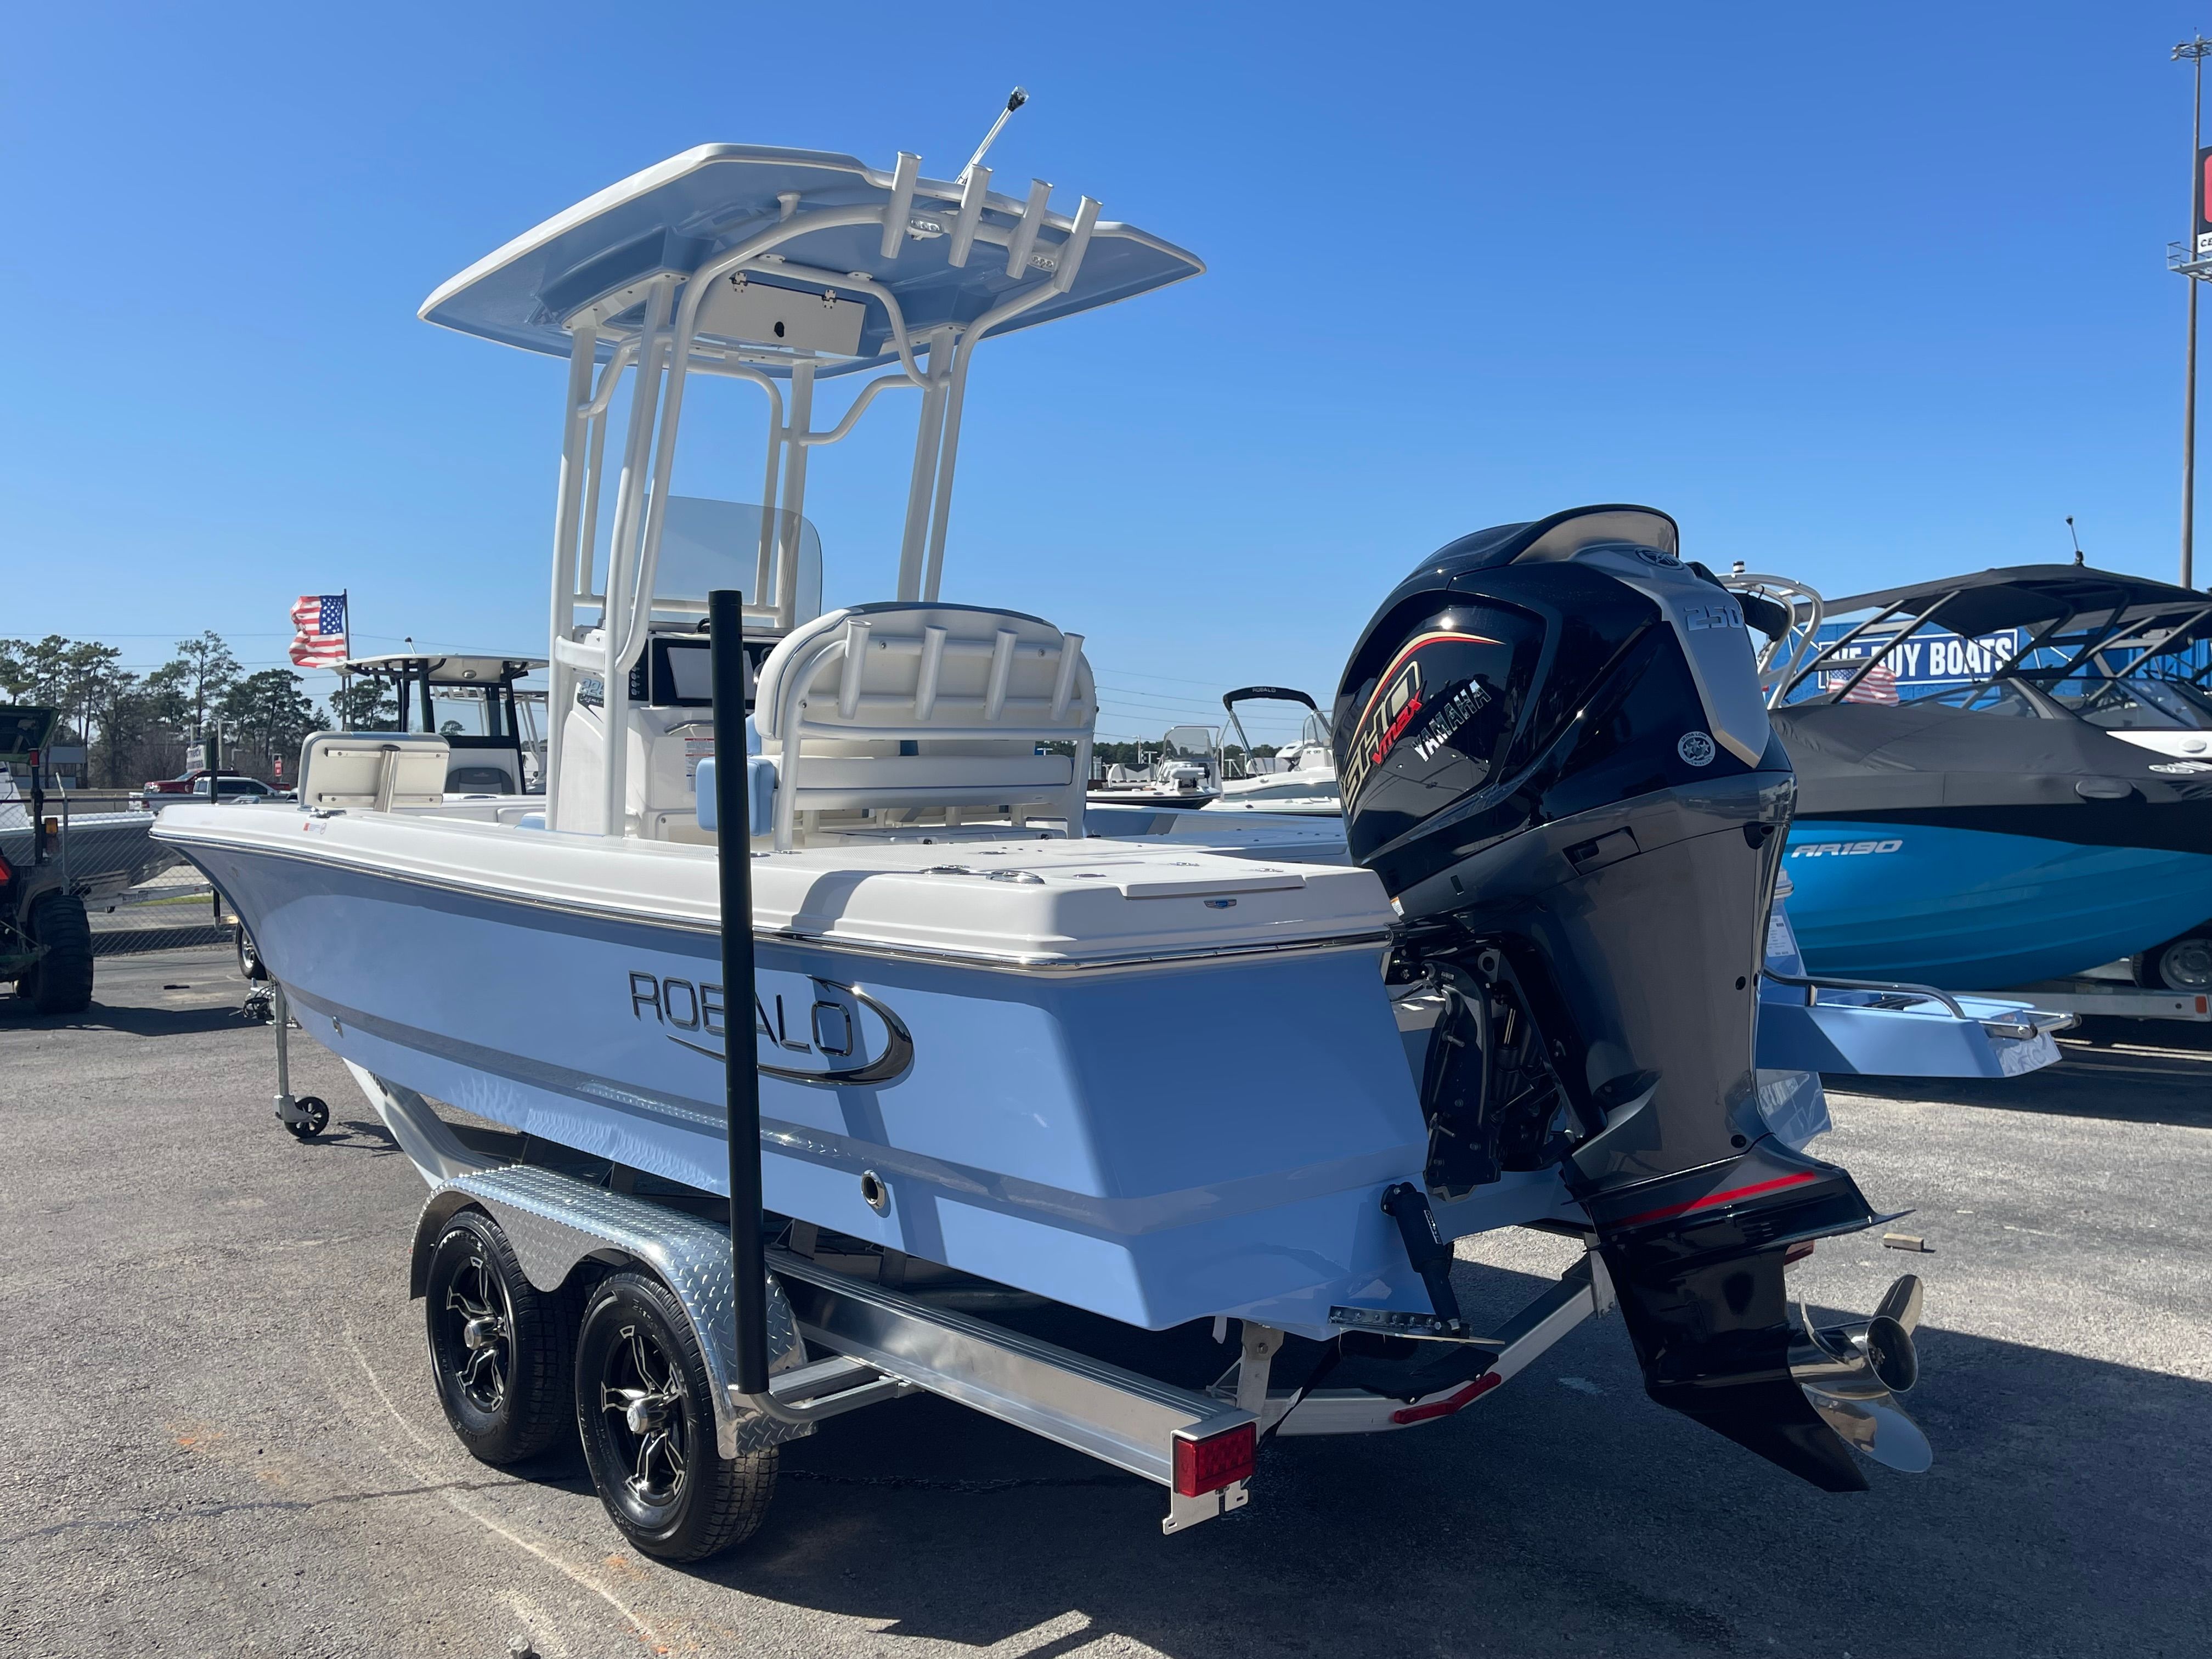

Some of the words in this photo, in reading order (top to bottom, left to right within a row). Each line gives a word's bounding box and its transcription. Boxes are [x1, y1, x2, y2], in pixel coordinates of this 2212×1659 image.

[1684, 605, 1743, 631] 250
[1929, 637, 2012, 676] BOATS
[1340, 661, 1422, 815] SHO
[1410, 679, 1492, 761] YAMAHA
[1791, 839, 1903, 858] AR190
